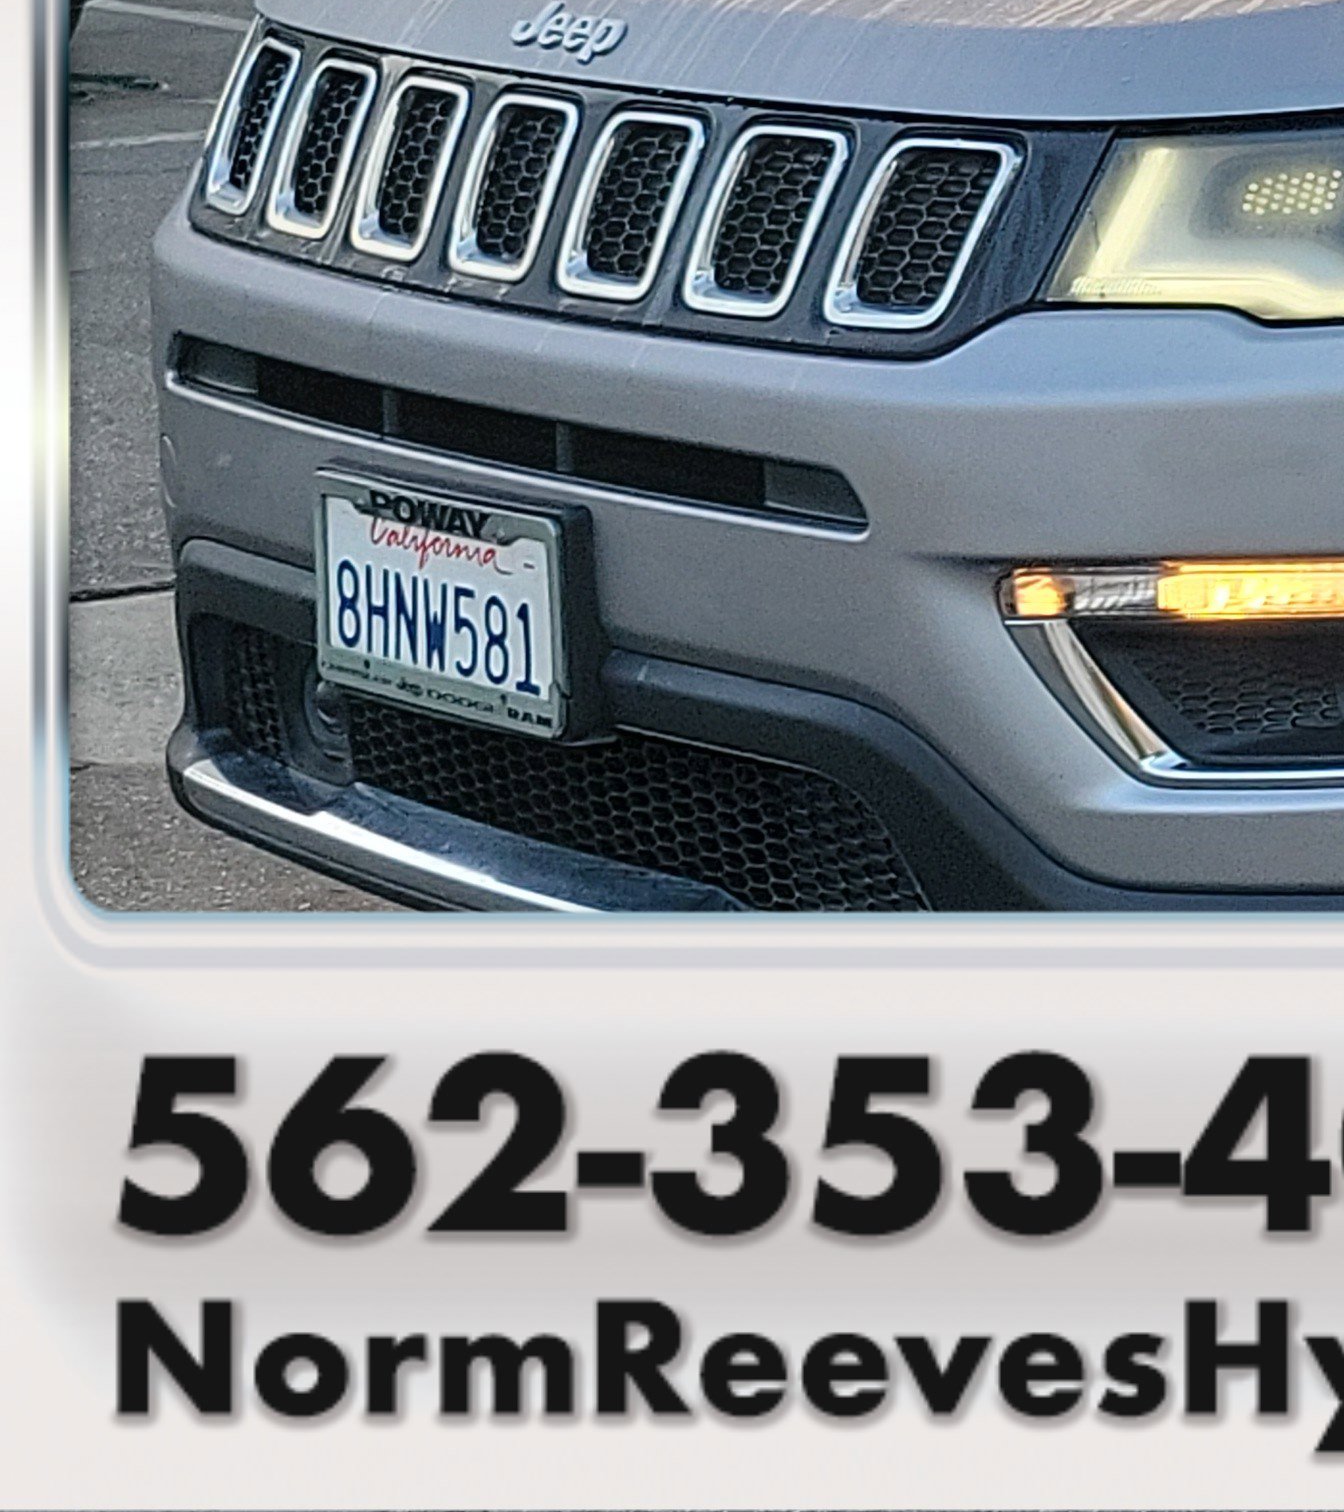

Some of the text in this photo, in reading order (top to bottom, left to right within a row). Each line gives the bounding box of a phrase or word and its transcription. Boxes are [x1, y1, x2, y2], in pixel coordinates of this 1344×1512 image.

[510, 0, 628, 65] Jeep
[369, 489, 491, 539] POWAY
[369, 515, 515, 575] California
[336, 559, 541, 696] 8HNW581
